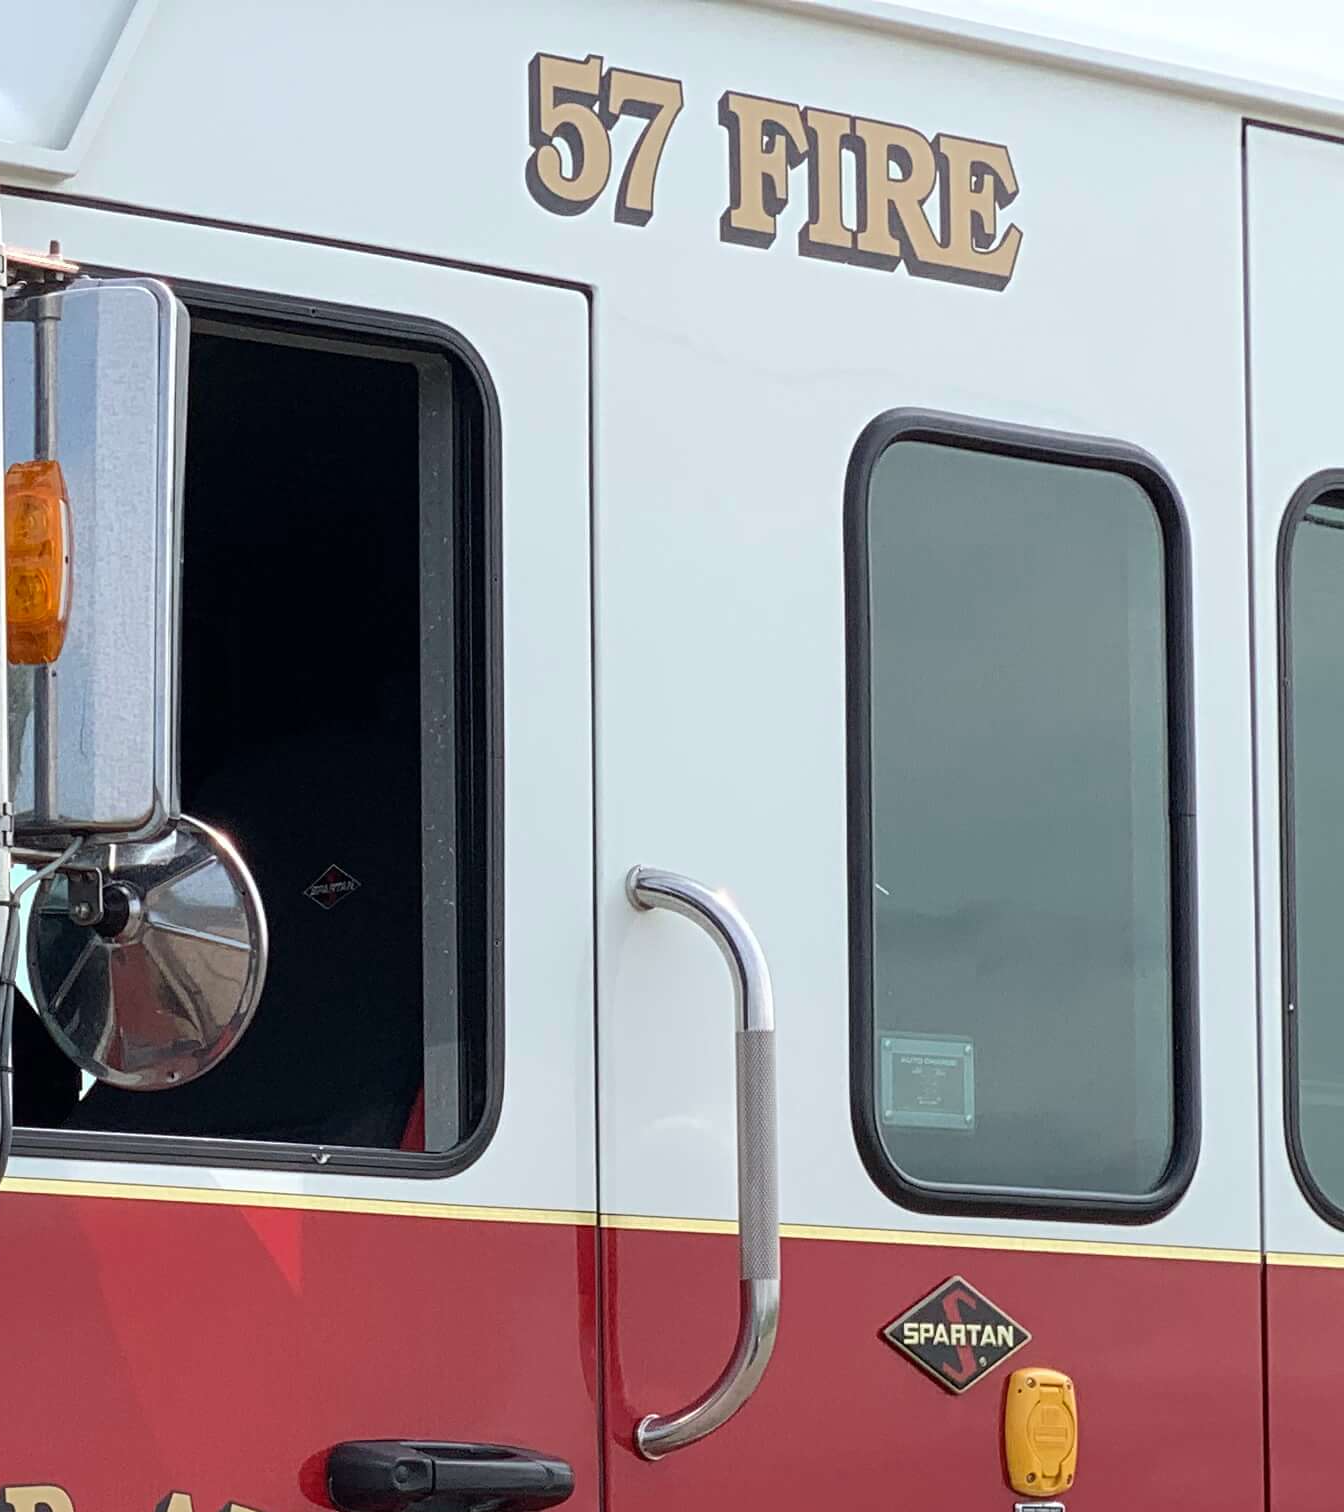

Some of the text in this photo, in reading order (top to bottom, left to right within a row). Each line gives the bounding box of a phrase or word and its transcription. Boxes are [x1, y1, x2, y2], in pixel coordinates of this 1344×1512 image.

[525, 52, 1022, 291] 57 FIRE
[903, 1323, 1014, 1348] SPARTAN
